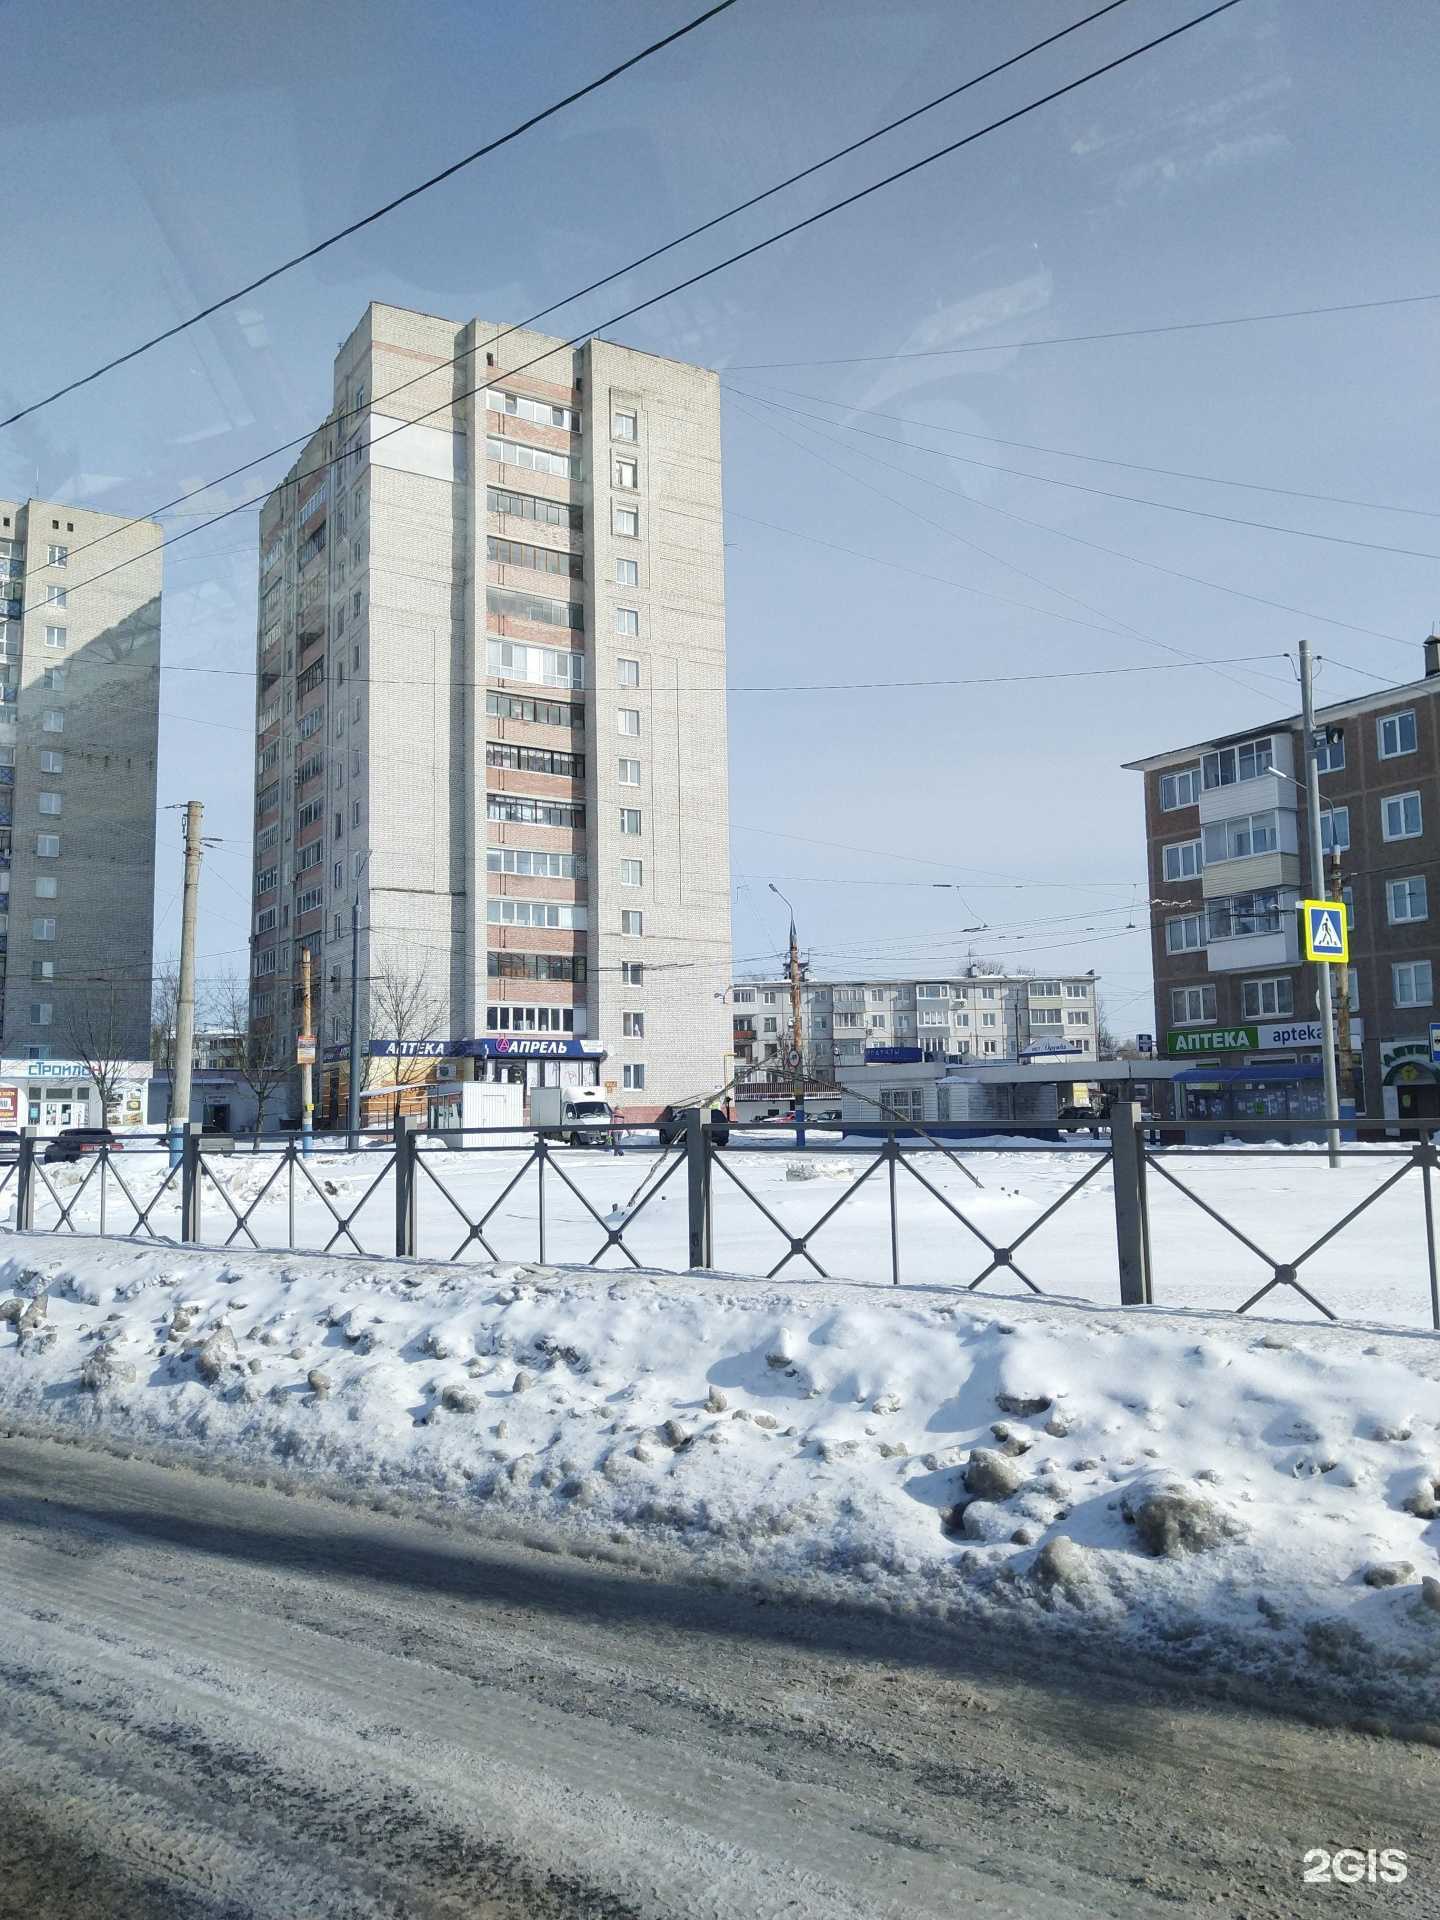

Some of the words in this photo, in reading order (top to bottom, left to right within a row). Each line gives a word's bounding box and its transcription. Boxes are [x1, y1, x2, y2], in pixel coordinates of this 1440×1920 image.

[508, 1040, 567, 1053] АПРЕЛЬ
[1176, 1031, 1250, 1051] АПТЕКА
[385, 1042, 445, 1055] АПТЕКА
